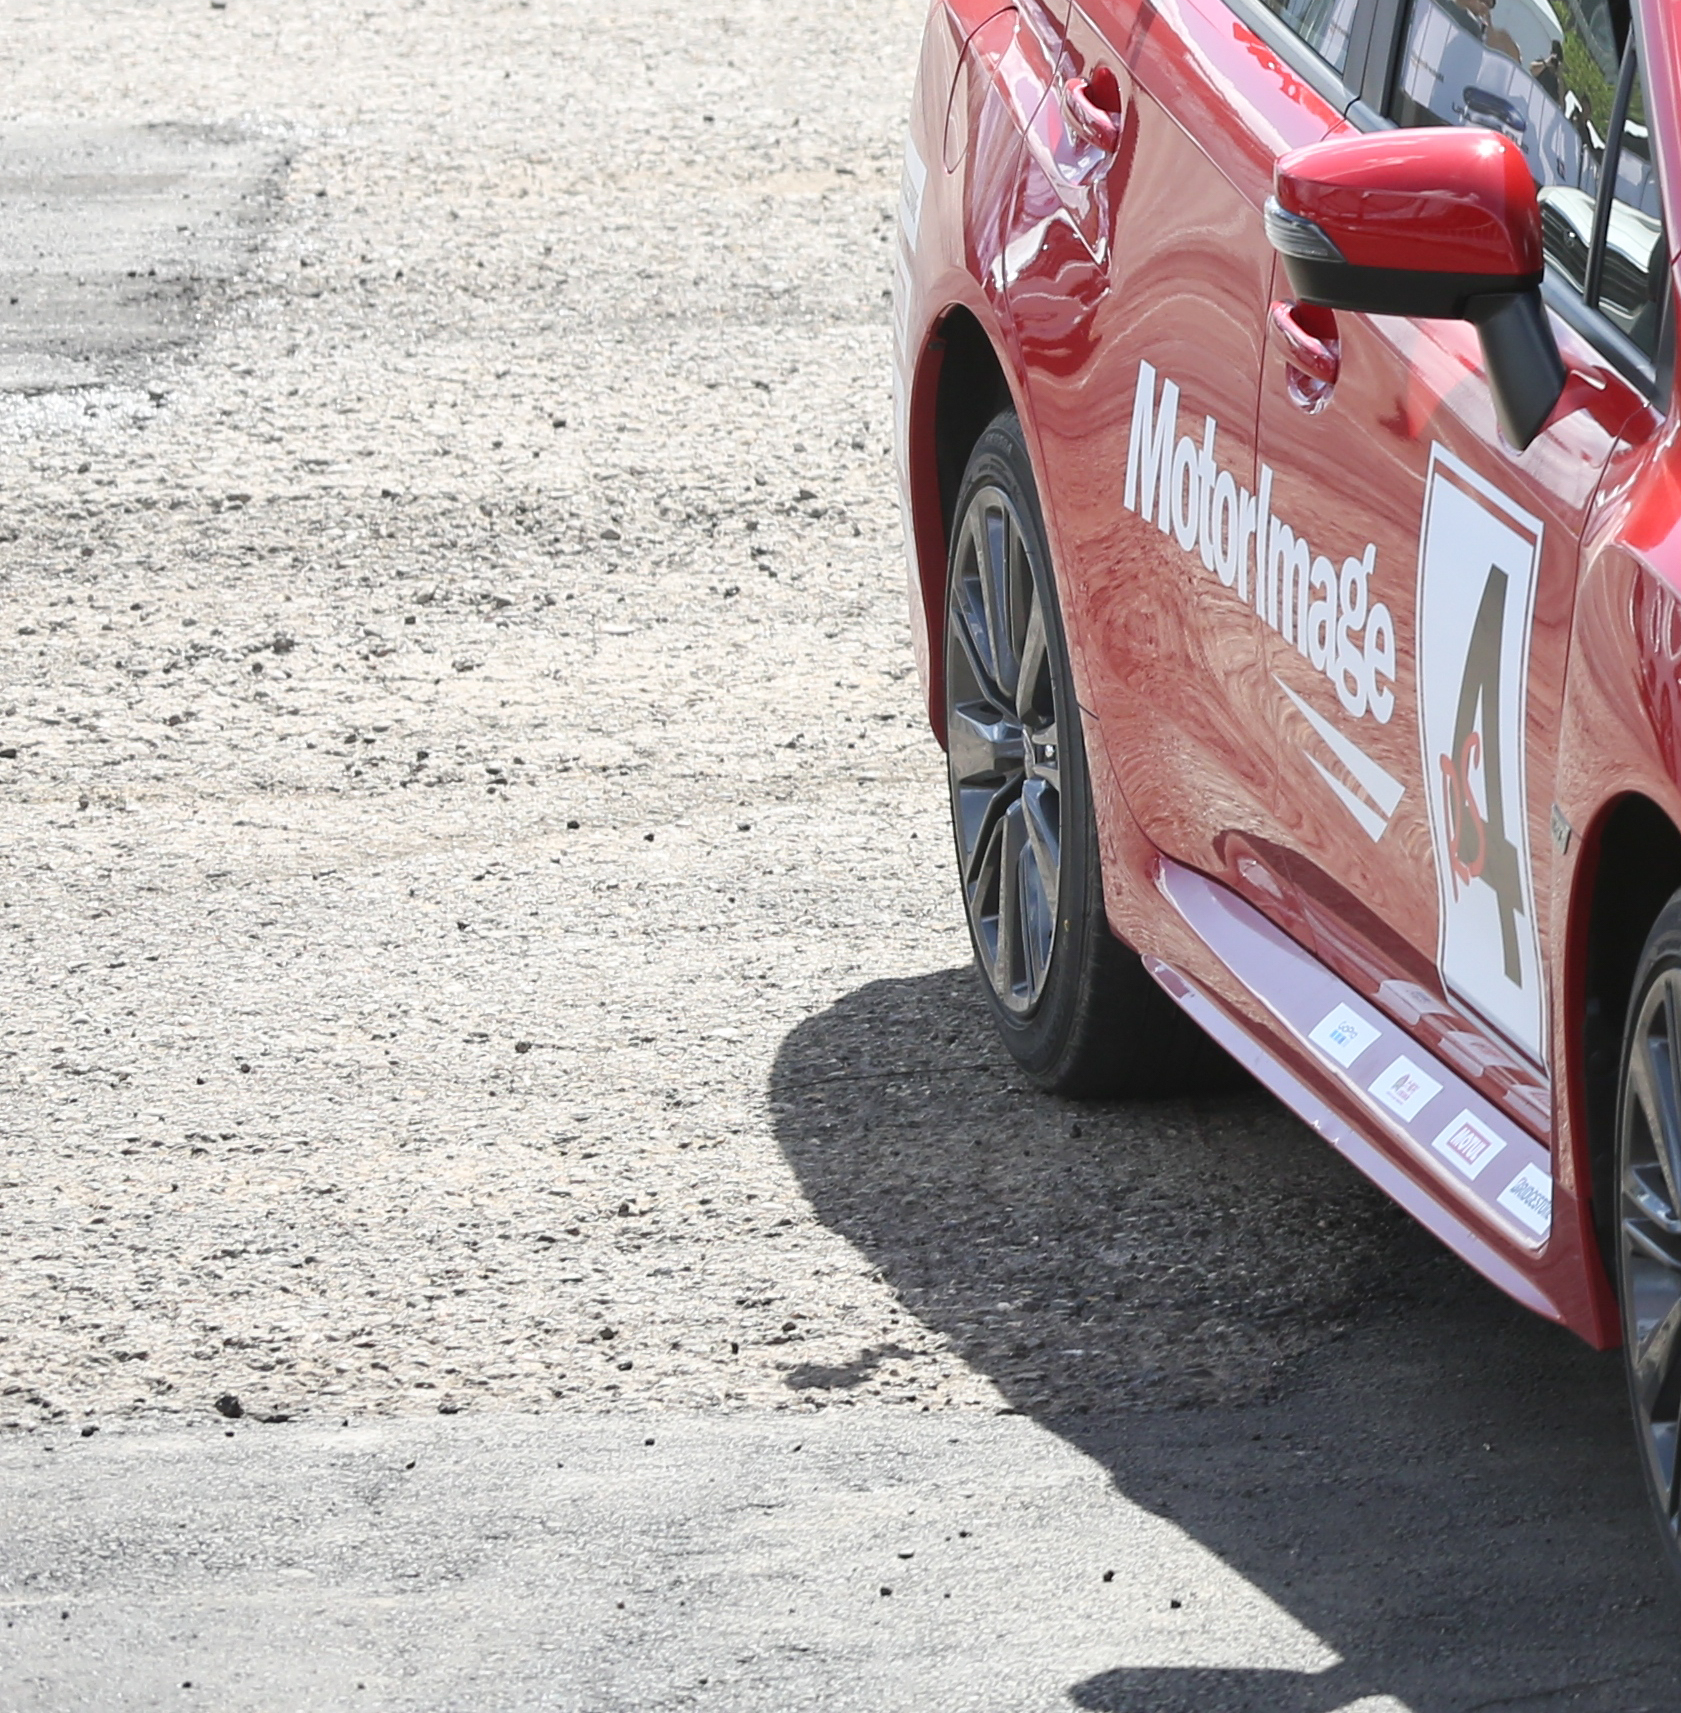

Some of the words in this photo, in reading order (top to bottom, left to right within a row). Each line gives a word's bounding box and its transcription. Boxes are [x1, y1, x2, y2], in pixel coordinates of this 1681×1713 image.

[1123, 359, 1397, 725] MotorImage
[1449, 563, 1527, 989] 4
[1449, 1126, 1487, 1162] MOTUL
